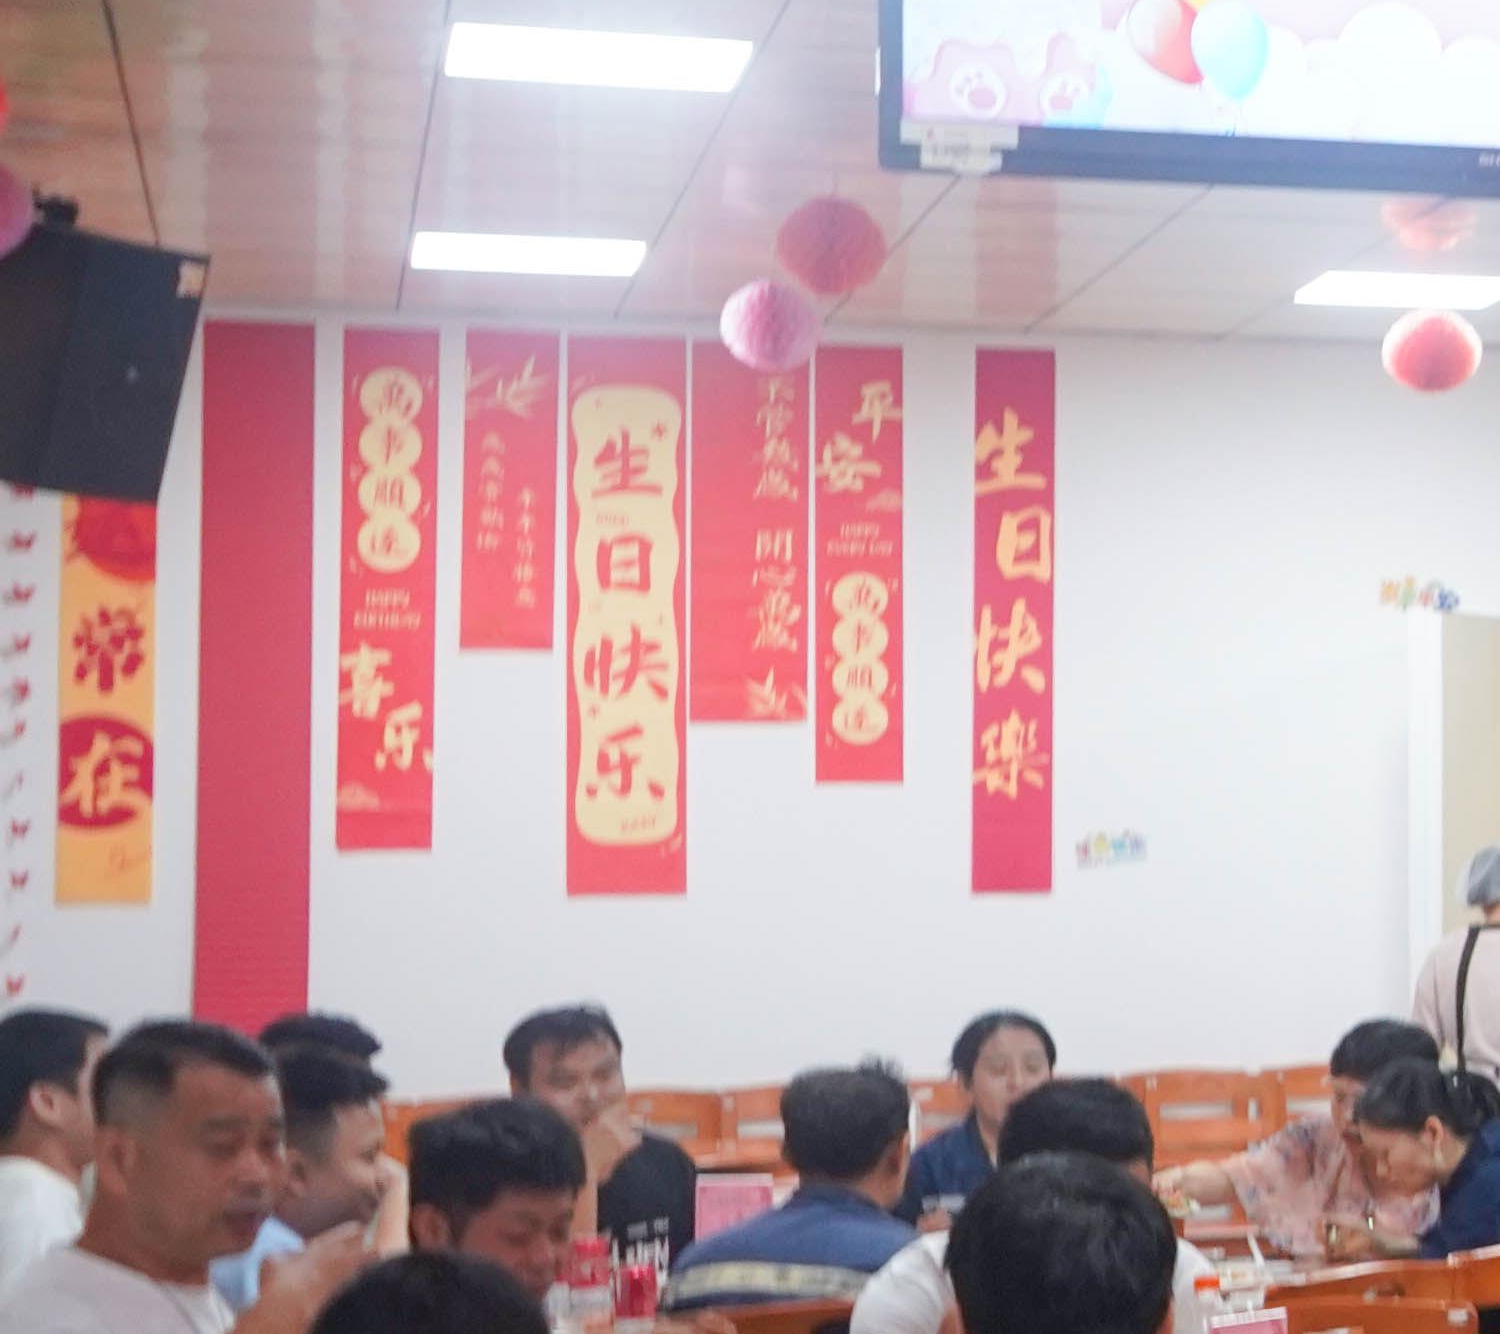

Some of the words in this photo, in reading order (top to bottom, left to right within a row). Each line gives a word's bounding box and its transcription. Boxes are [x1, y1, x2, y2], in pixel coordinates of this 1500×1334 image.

[816, 380, 903, 494] 平安
[584, 424, 670, 801] 生日快乐
